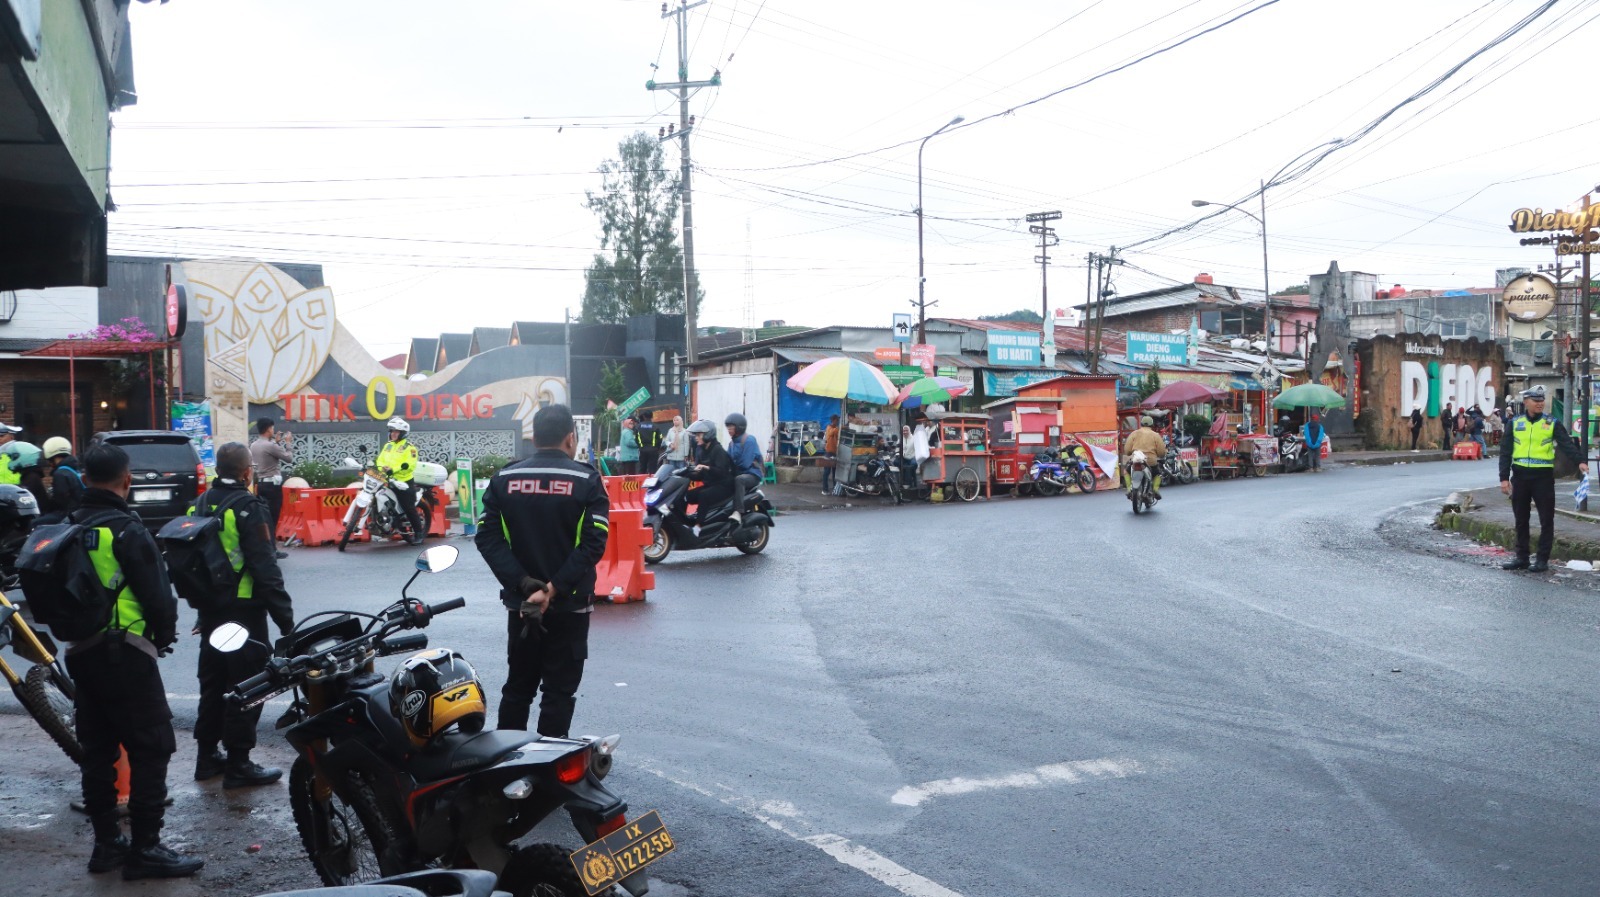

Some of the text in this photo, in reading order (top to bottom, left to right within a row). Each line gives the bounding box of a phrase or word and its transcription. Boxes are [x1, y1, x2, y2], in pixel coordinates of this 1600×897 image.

[988, 334, 1040, 347] WARUNG MAKAN
[1130, 331, 1185, 345] WARUNG MAKAN
[997, 347, 1009, 360] BU
[1146, 343, 1171, 354] DIENG
[1405, 342, 1445, 356] Welcome to
[278, 375, 494, 422] TITIK 0 DIENG
[507, 480, 574, 496] POLISI
[625, 823, 643, 840] IX
